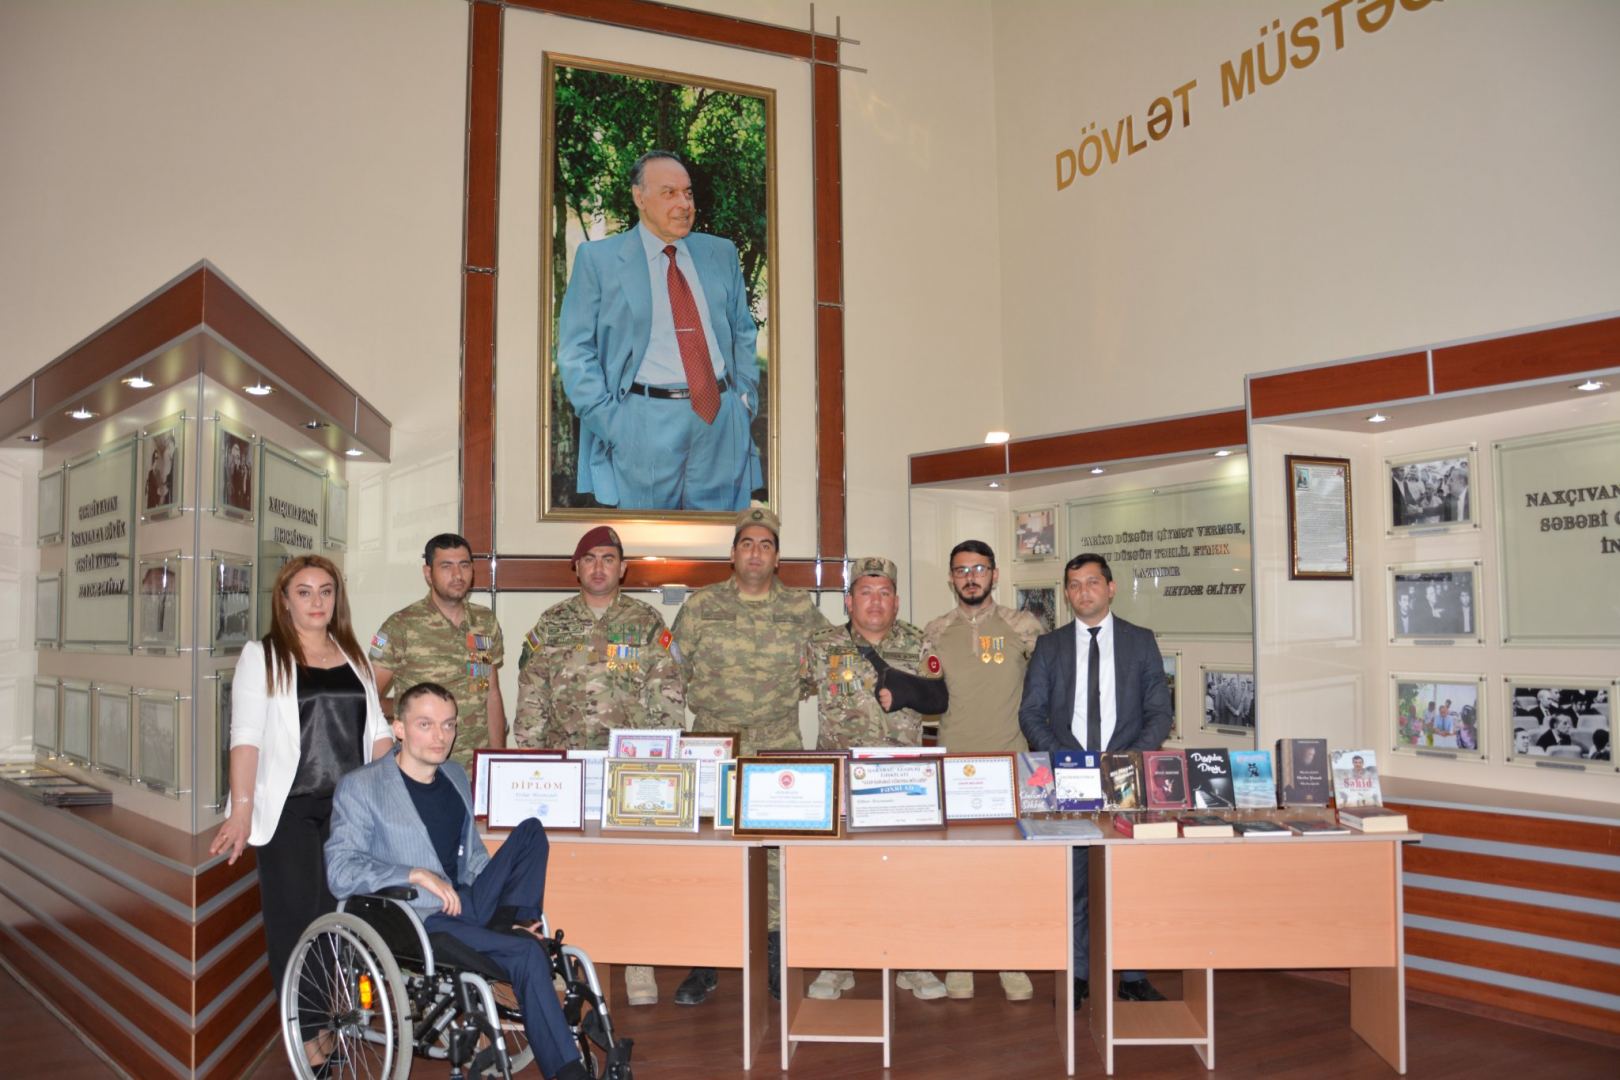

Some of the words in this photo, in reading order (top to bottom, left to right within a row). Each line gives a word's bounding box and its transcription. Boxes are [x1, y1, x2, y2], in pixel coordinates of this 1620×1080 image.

[1055, 79, 1198, 192] DÖVLƏT
[1219, 0, 1444, 108] MÜSTƏ
[1540, 509, 1608, 532] SƏBƏBİ
[1163, 585, 1204, 597] HEYDƏR
[1206, 581, 1246, 596] ƏLİYEV
[511, 780, 563, 790] DİPLOM
